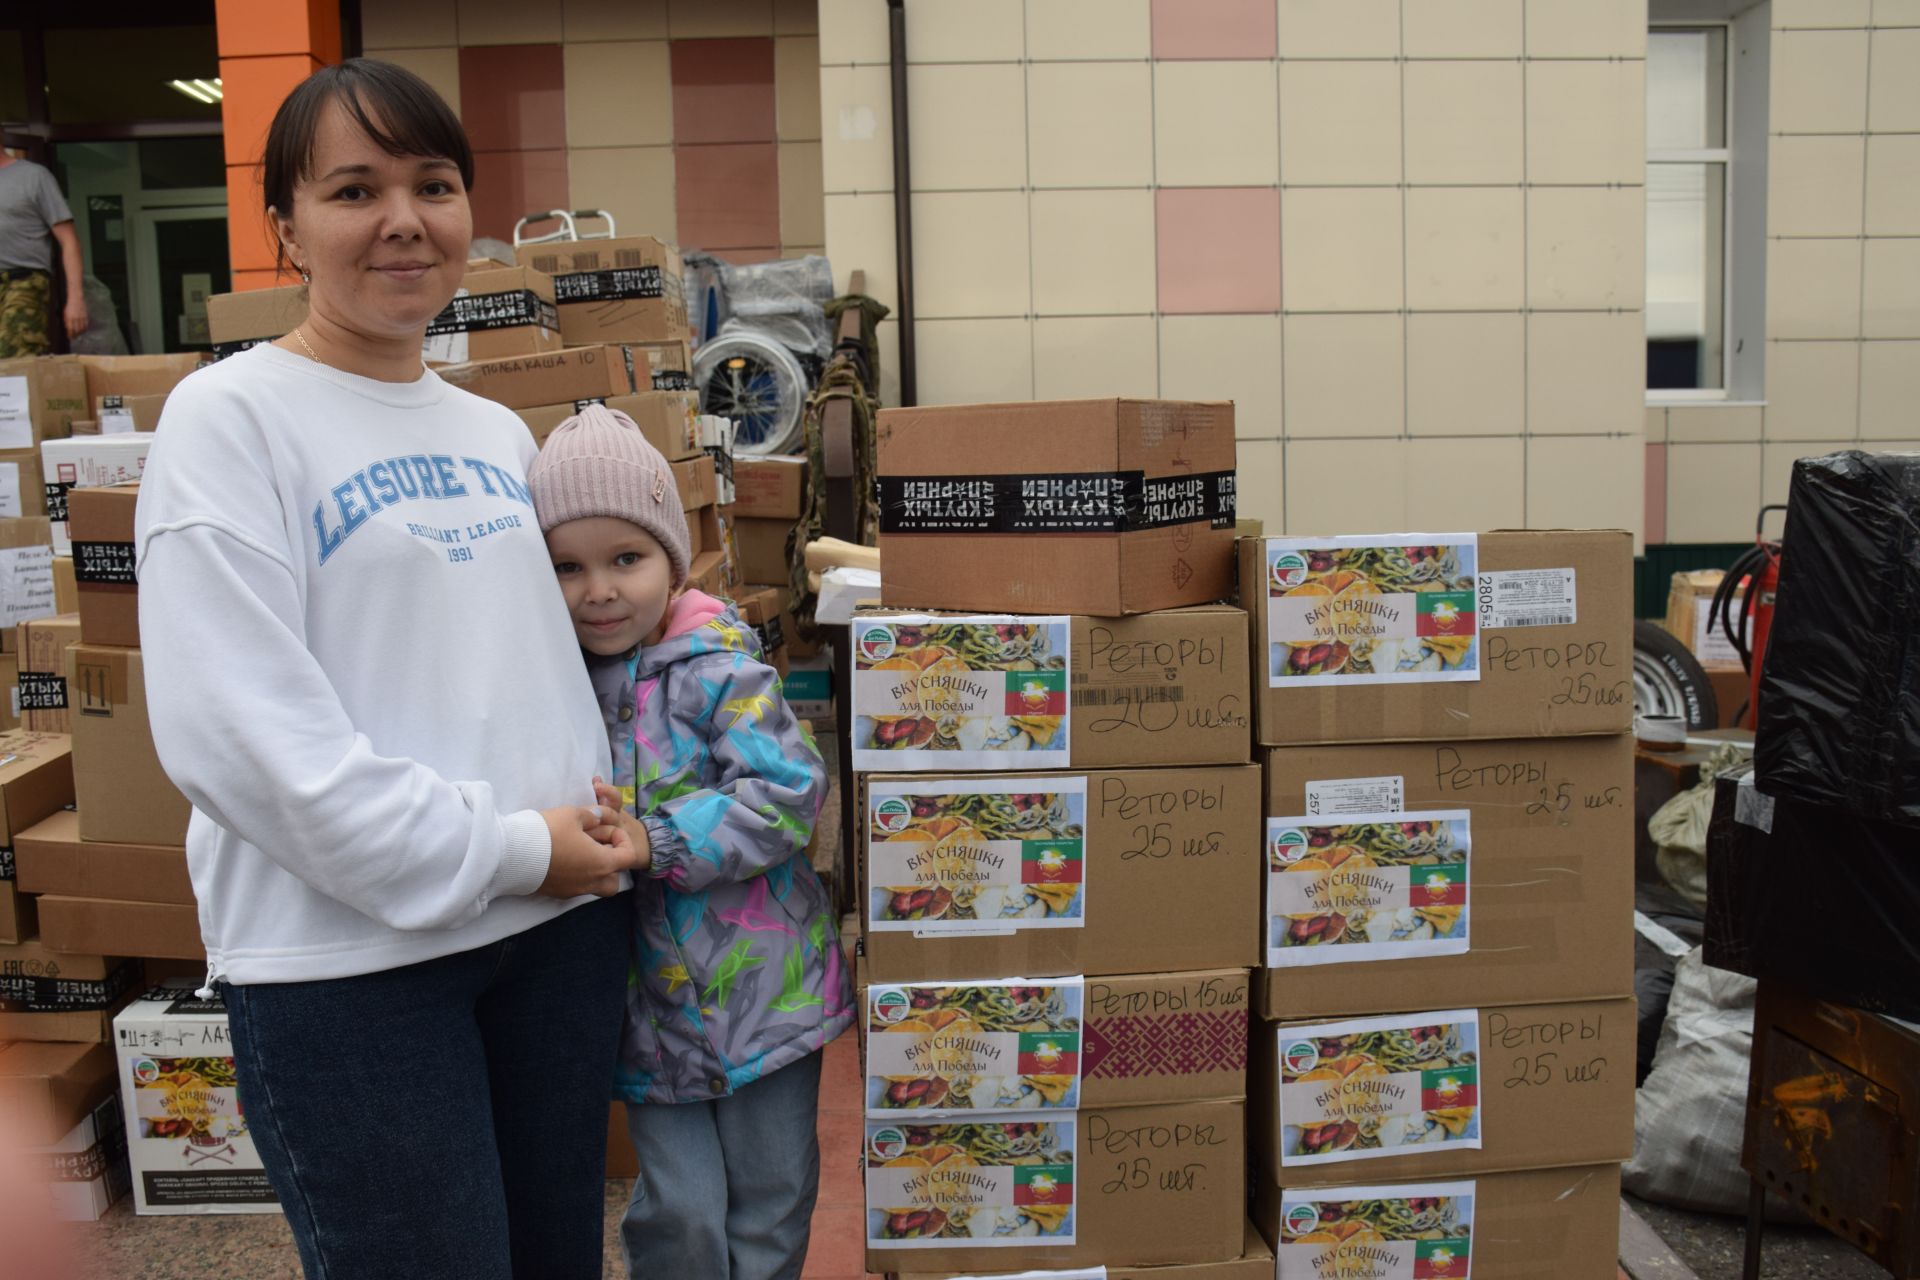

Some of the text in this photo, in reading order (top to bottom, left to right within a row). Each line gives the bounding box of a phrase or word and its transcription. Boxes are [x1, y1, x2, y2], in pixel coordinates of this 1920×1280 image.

[525, 359, 566, 372] КАША
[579, 352, 595, 365] 10
[313, 454, 533, 567] LEISURE TIM
[904, 500, 981, 517] КРУТЫХ
[1022, 499, 1110, 516] КРУТЫХ
[407, 515, 522, 543] BRILLIANT LEAGUE
[84, 559, 134, 572] УТЫХ
[448, 547, 474, 563] 1991
[1304, 599, 1400, 626] ВКУСНЯШКИ
[1313, 622, 1386, 638] для Победы
[1089, 627, 1224, 675] Реторы
[1488, 636, 1616, 672] Реторы
[20, 681, 62, 695] УТЫХ
[891, 674, 989, 701] ВКУСНЯШКИ
[1551, 672, 1596, 705] 25
[899, 698, 975, 714] для Победы
[1436, 747, 1546, 791] Реторы
[1101, 777, 1224, 820] Реторы
[1526, 783, 1574, 815] 25
[1120, 823, 1172, 861] 25
[905, 844, 1005, 872] ВКУСНЯШКИ
[914, 868, 991, 884] для Победы
[1304, 872, 1395, 899] ВКУСНЯШКИ
[1312, 894, 1381, 912] для Победы
[1089, 983, 1187, 1016] Реторы
[1487, 1012, 1603, 1049] Реторы
[904, 1037, 1001, 1062] ВКУСНЯШКИ
[911, 1058, 988, 1074] для Победы
[1503, 1053, 1558, 1088] 25
[1315, 1080, 1406, 1107] ВКУСНЯШКИ
[1323, 1102, 1394, 1119] для Победы
[1087, 1115, 1228, 1155] Реторы
[902, 1170, 998, 1194] ВКУСНЯШКИ
[1101, 1157, 1150, 1194] 25
[910, 1190, 984, 1205] для Победы
[1311, 1246, 1400, 1270] ВКУСНЯШКИ
[1340, 1266, 1386, 1279] Победы
